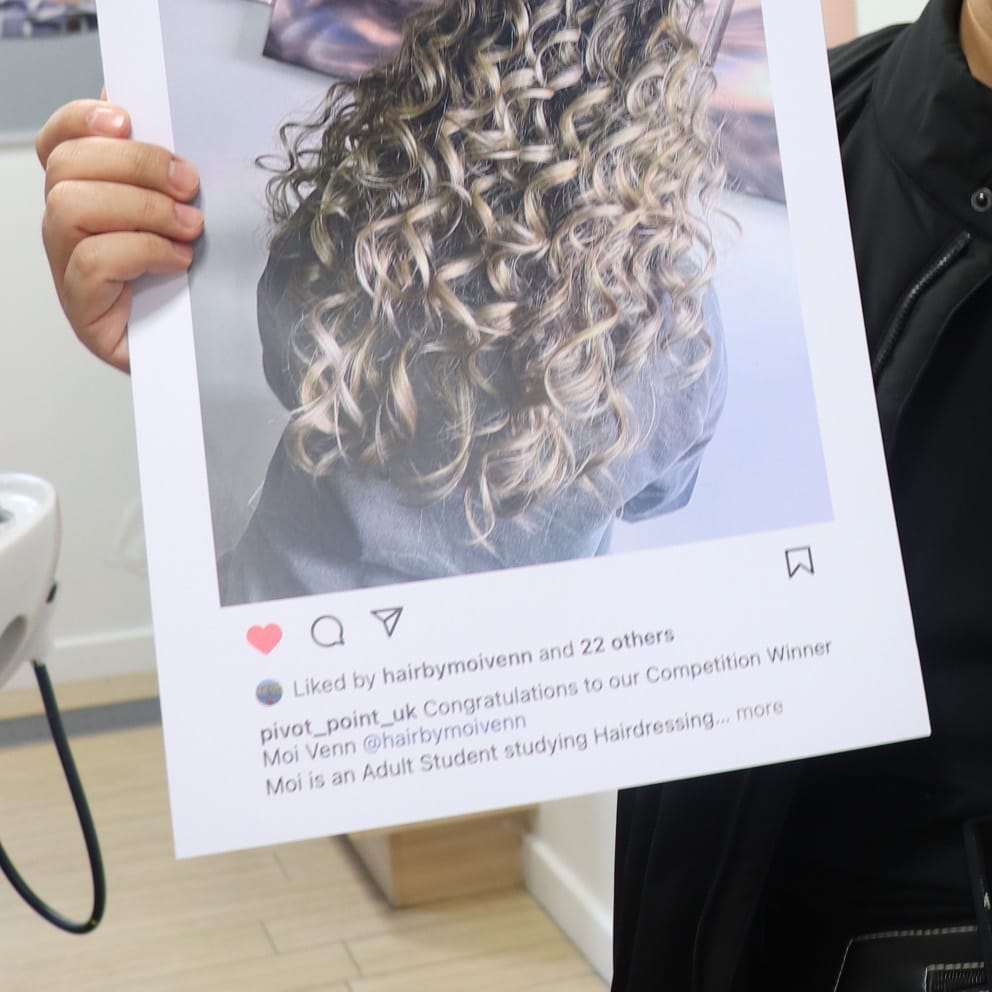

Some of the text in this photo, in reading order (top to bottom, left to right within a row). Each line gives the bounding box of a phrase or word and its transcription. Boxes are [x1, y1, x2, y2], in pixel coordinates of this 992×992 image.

[260, 639, 833, 745] pivot_point_uk Congratulations to our Competition Winner
[293, 627, 676, 698] Liked by hairbymoivenn and 22 others
[262, 713, 527, 768] Moi Venn @hairbymoivenn
[265, 773, 302, 796] Moi
[309, 769, 325, 790] is
[332, 767, 356, 786] an
[362, 757, 414, 782] Adult
[420, 745, 499, 773] Student
[504, 730, 588, 760] studying
[736, 699, 784, 722] more
